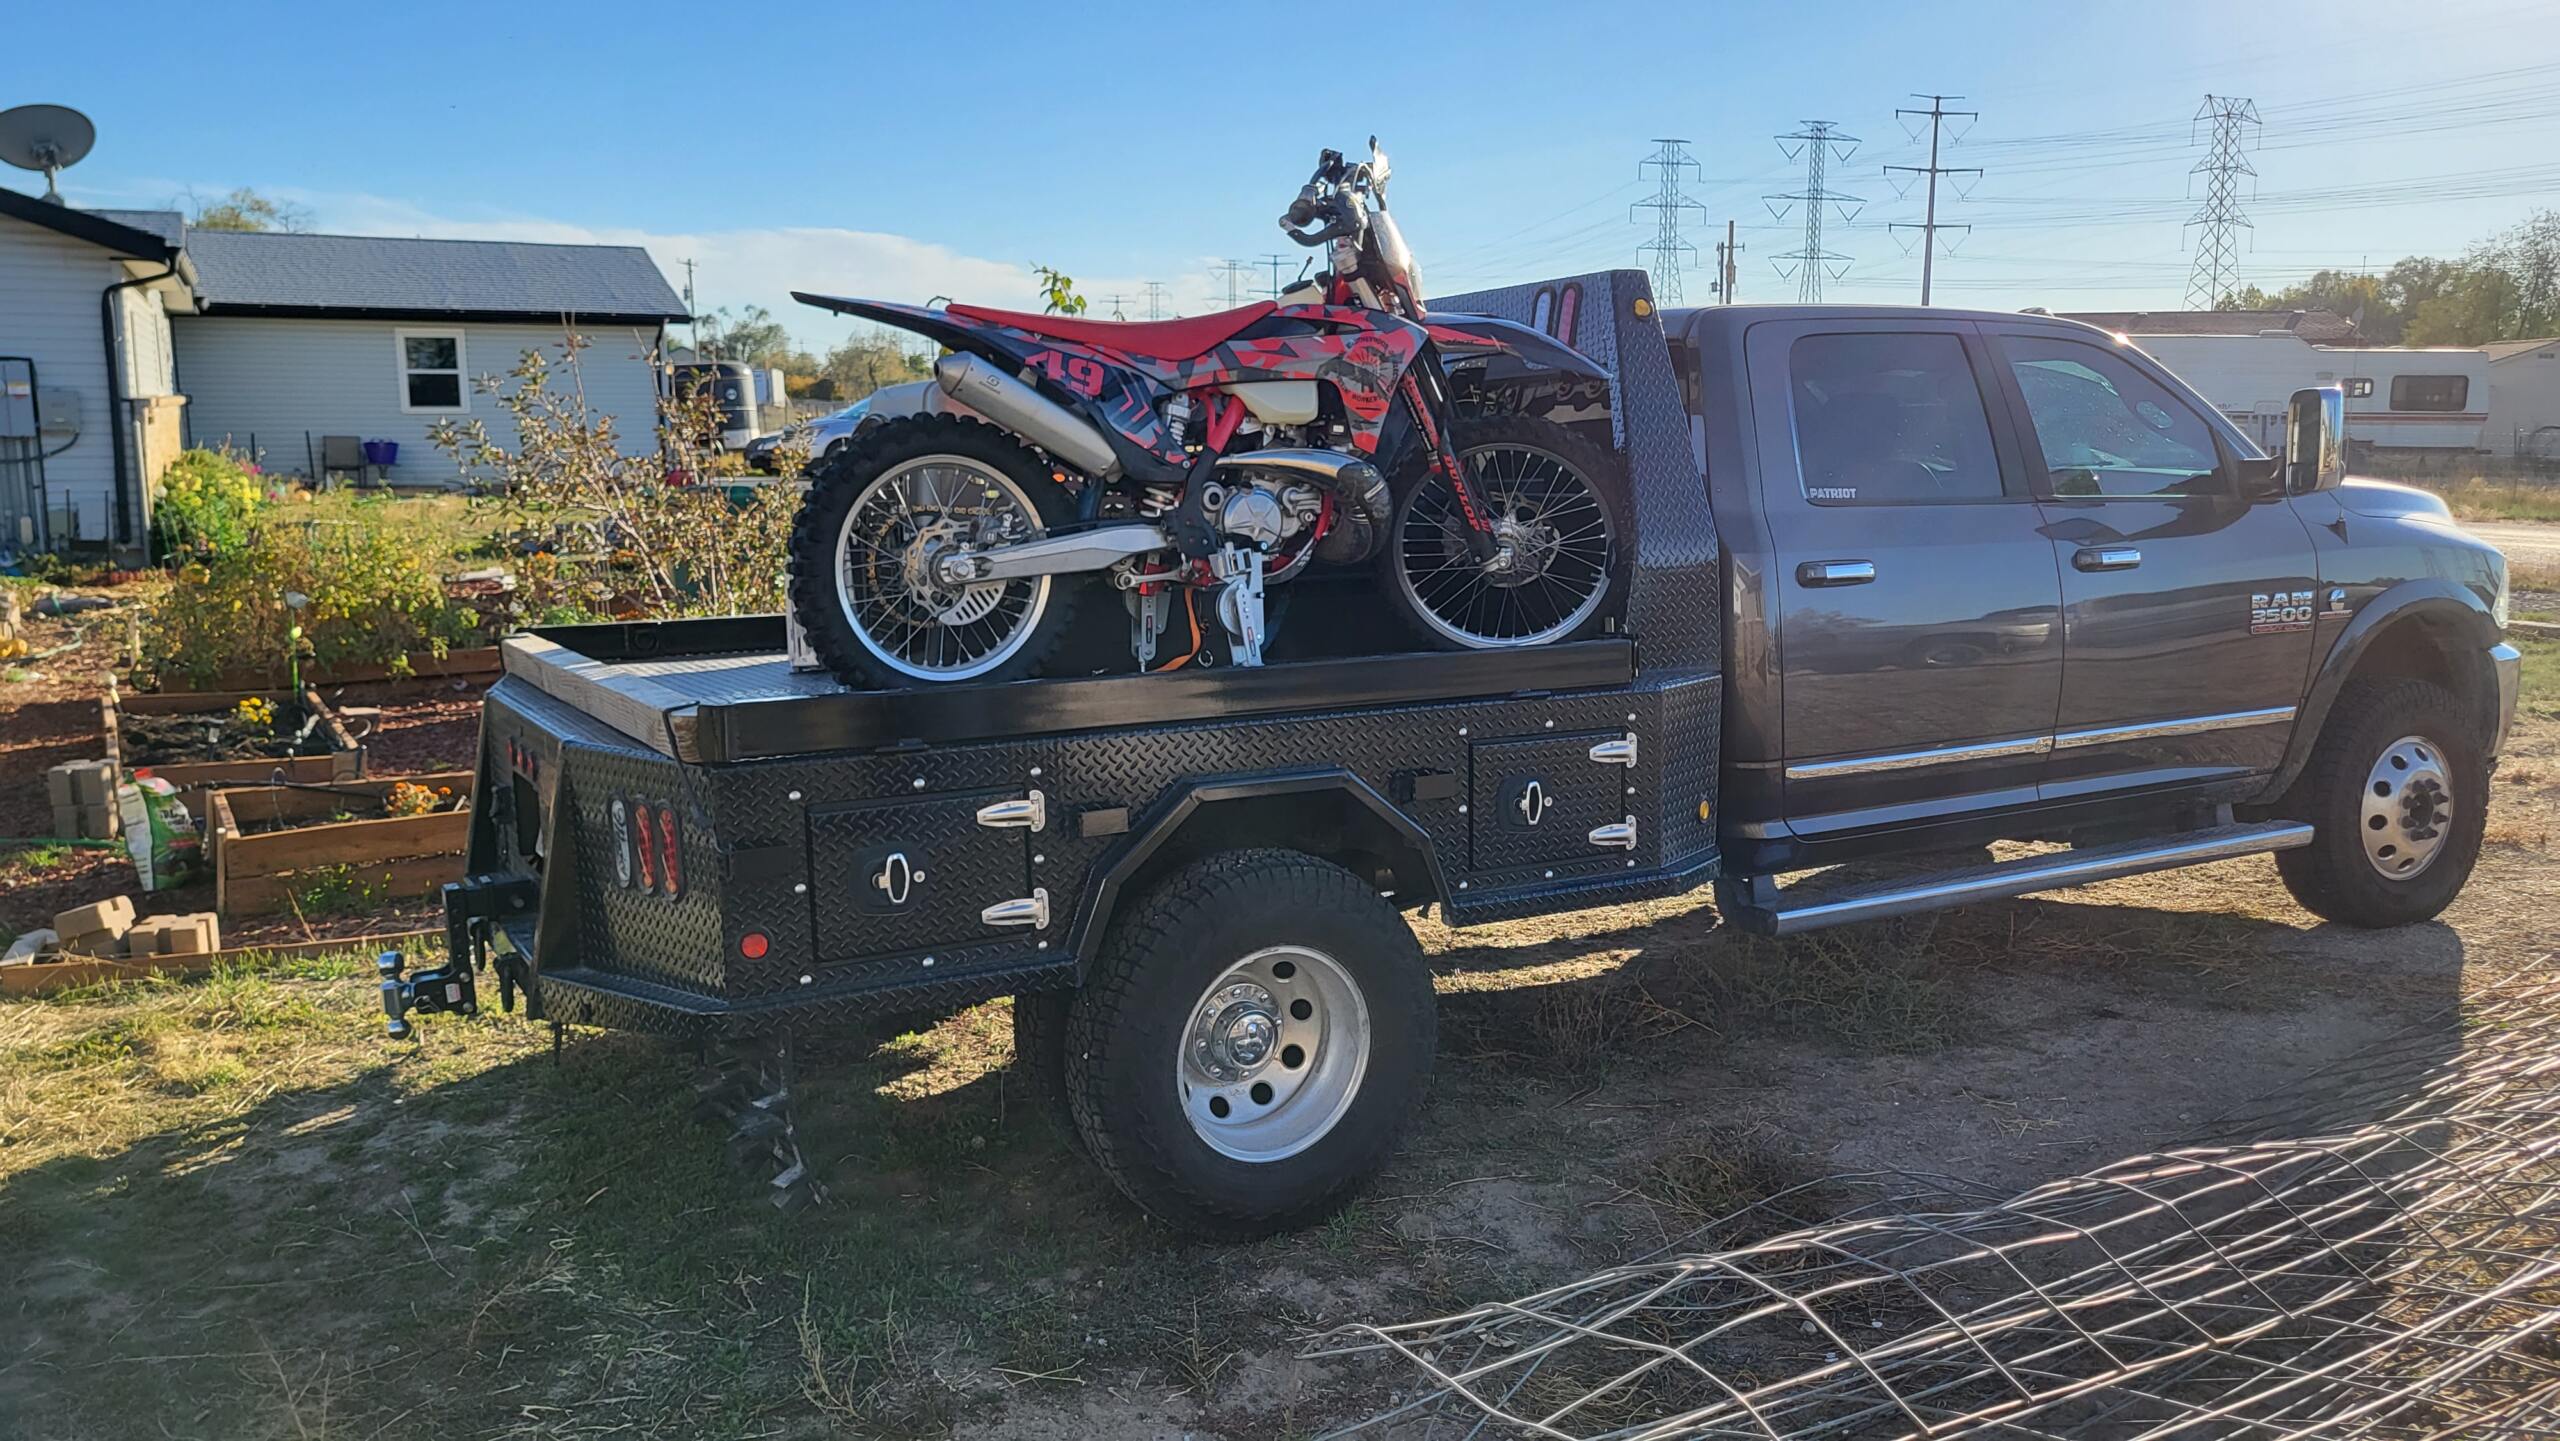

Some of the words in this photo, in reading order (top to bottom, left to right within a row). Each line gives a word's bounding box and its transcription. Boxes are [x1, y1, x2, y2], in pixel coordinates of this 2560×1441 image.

[1442, 454, 1481, 532] DUNLOP
[1809, 487, 1857, 499] PATRIOT
[2251, 591, 2313, 609] RAM
[2251, 606, 2313, 624] 3500
